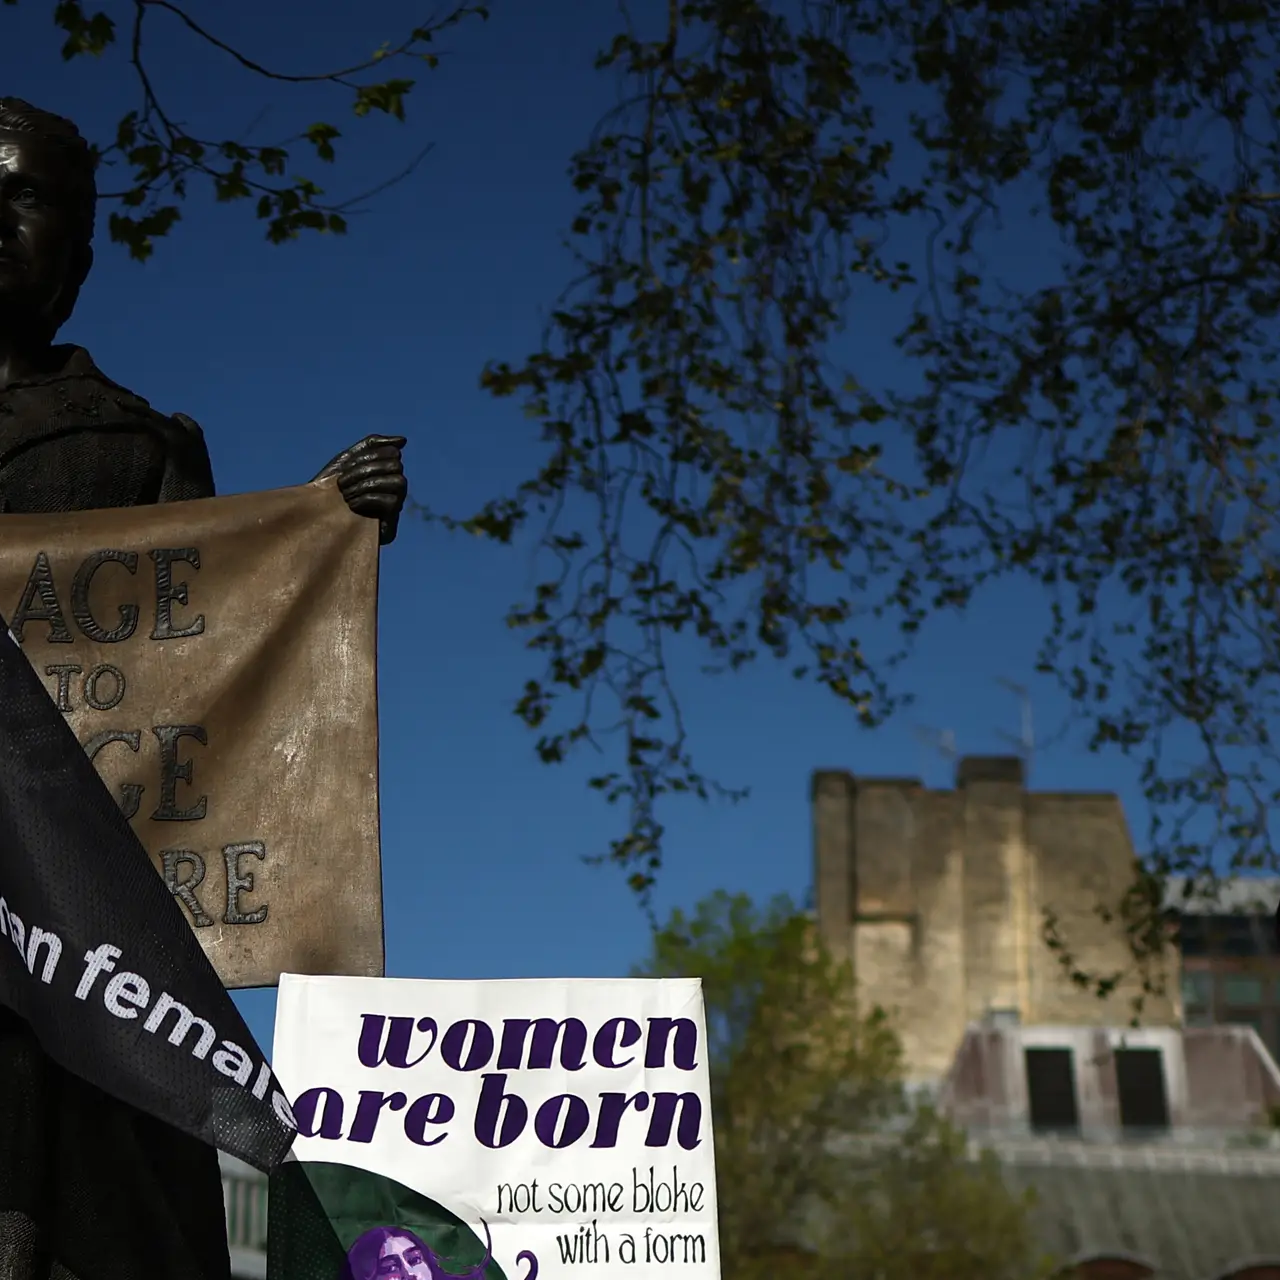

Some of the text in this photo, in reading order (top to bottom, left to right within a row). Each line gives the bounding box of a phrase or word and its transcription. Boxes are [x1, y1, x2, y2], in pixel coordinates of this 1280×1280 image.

[46, 664, 125, 712] TO
[357, 1014, 699, 1072] women
[295, 1073, 702, 1151] are born
[497, 1166, 705, 1214] not some bloke
[556, 1221, 706, 1264] with a form
